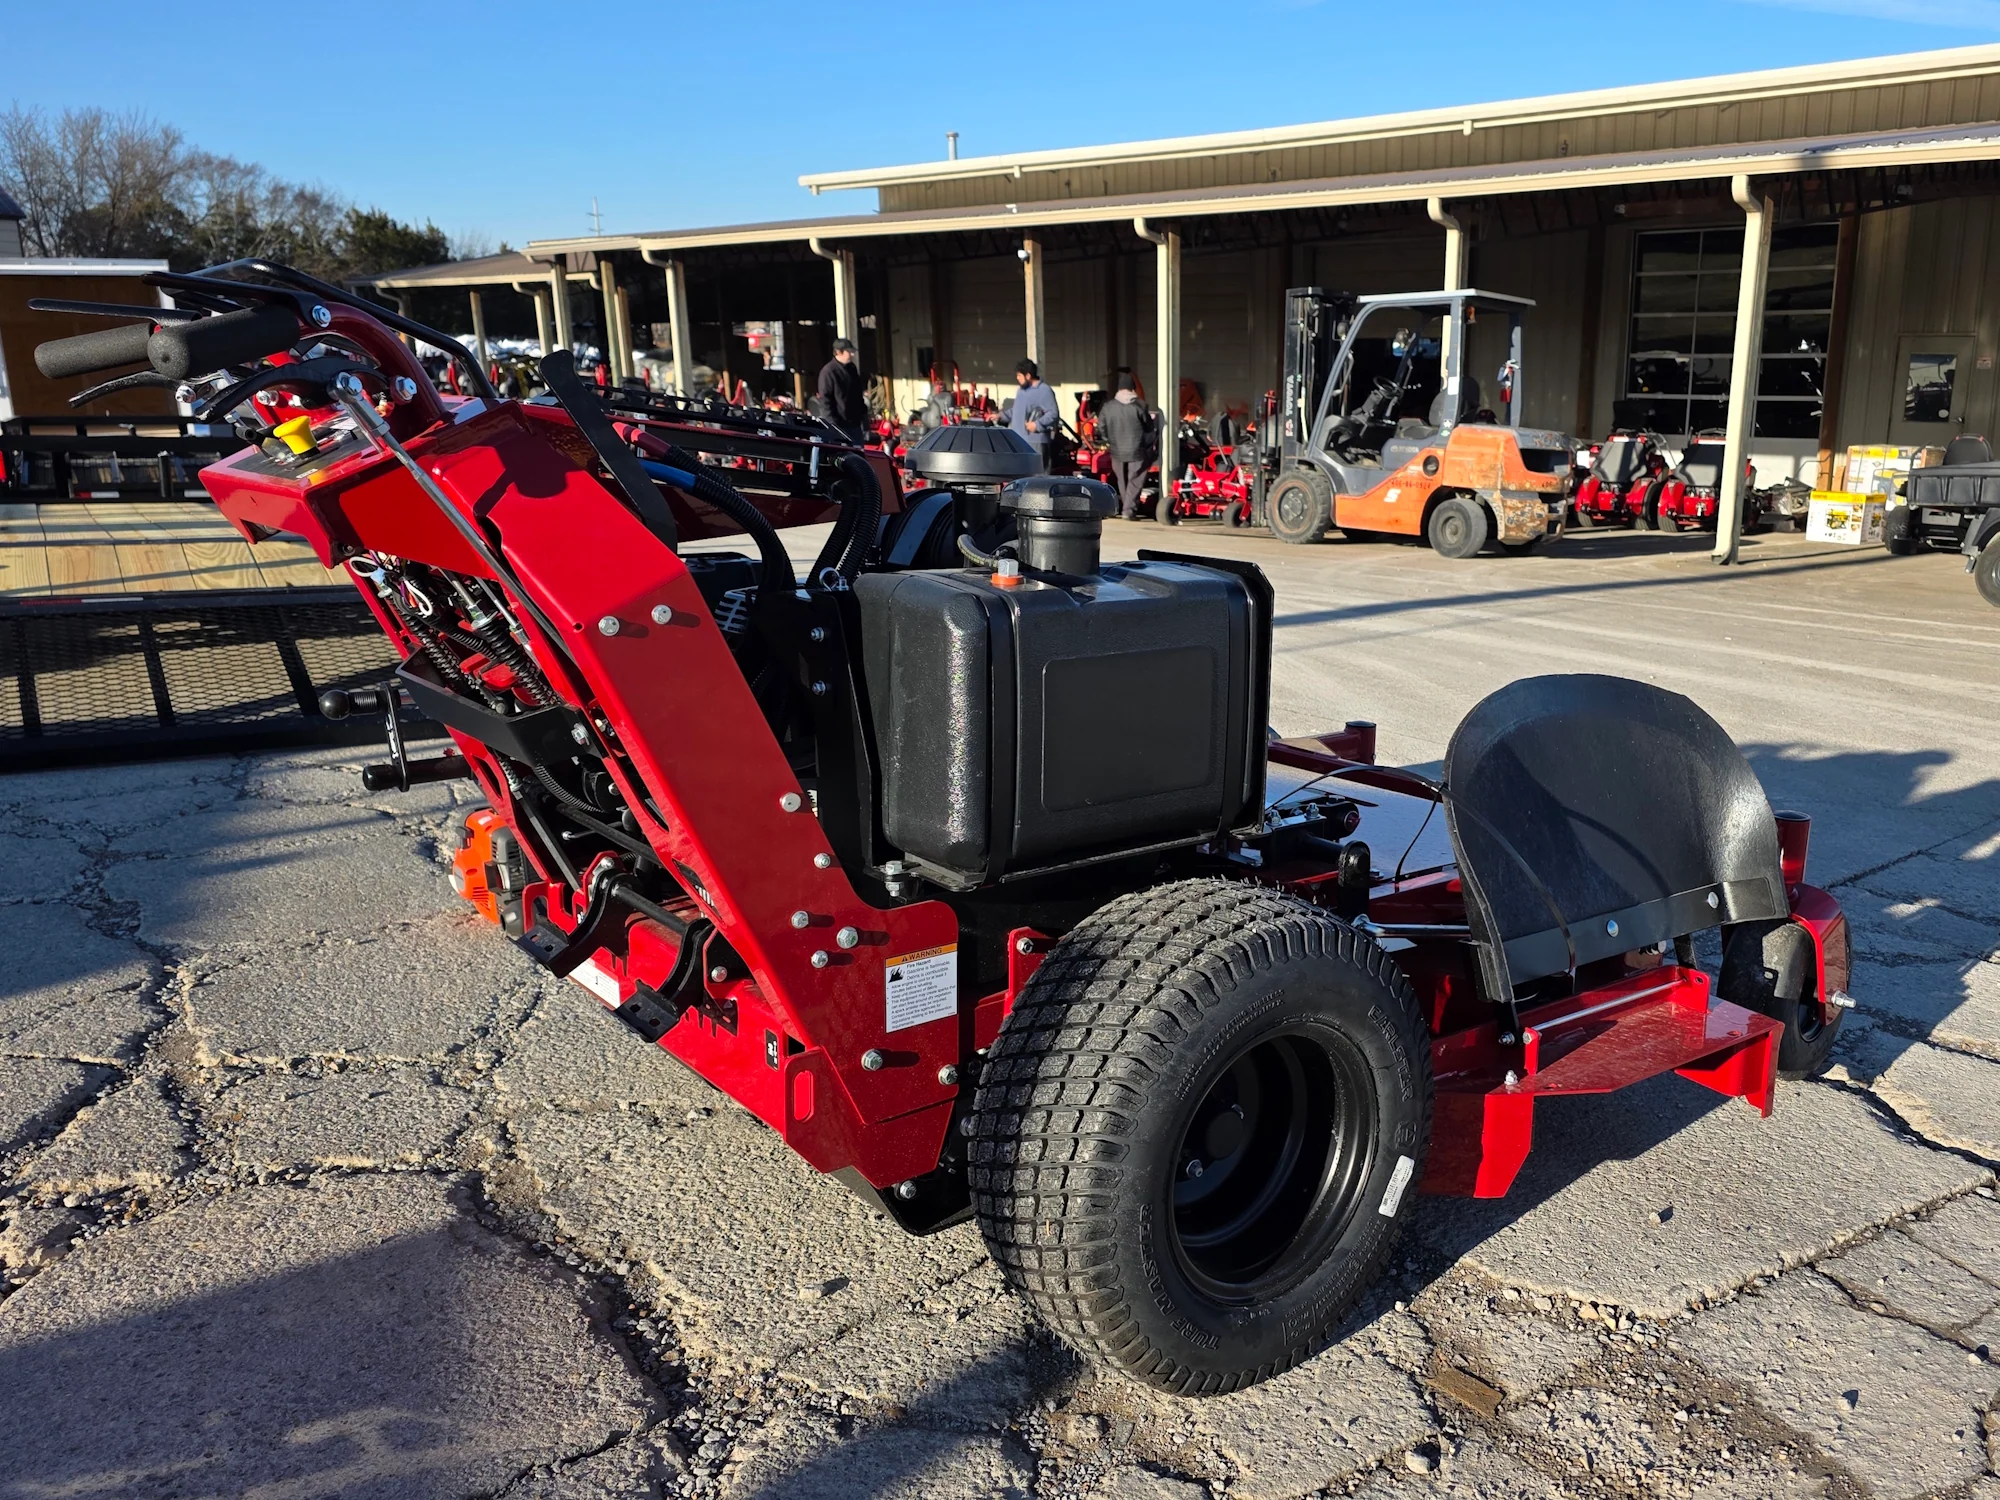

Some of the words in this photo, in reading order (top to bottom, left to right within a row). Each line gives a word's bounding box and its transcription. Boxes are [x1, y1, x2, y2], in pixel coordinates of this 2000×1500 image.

[1285, 374, 1294, 417] TOYOTA
[909, 948, 942, 960] WARNING
[1367, 1004, 1414, 1103] CARLSTAR
[1139, 1203, 1176, 1316] MASTER
[1169, 1317, 1221, 1351] TURF
